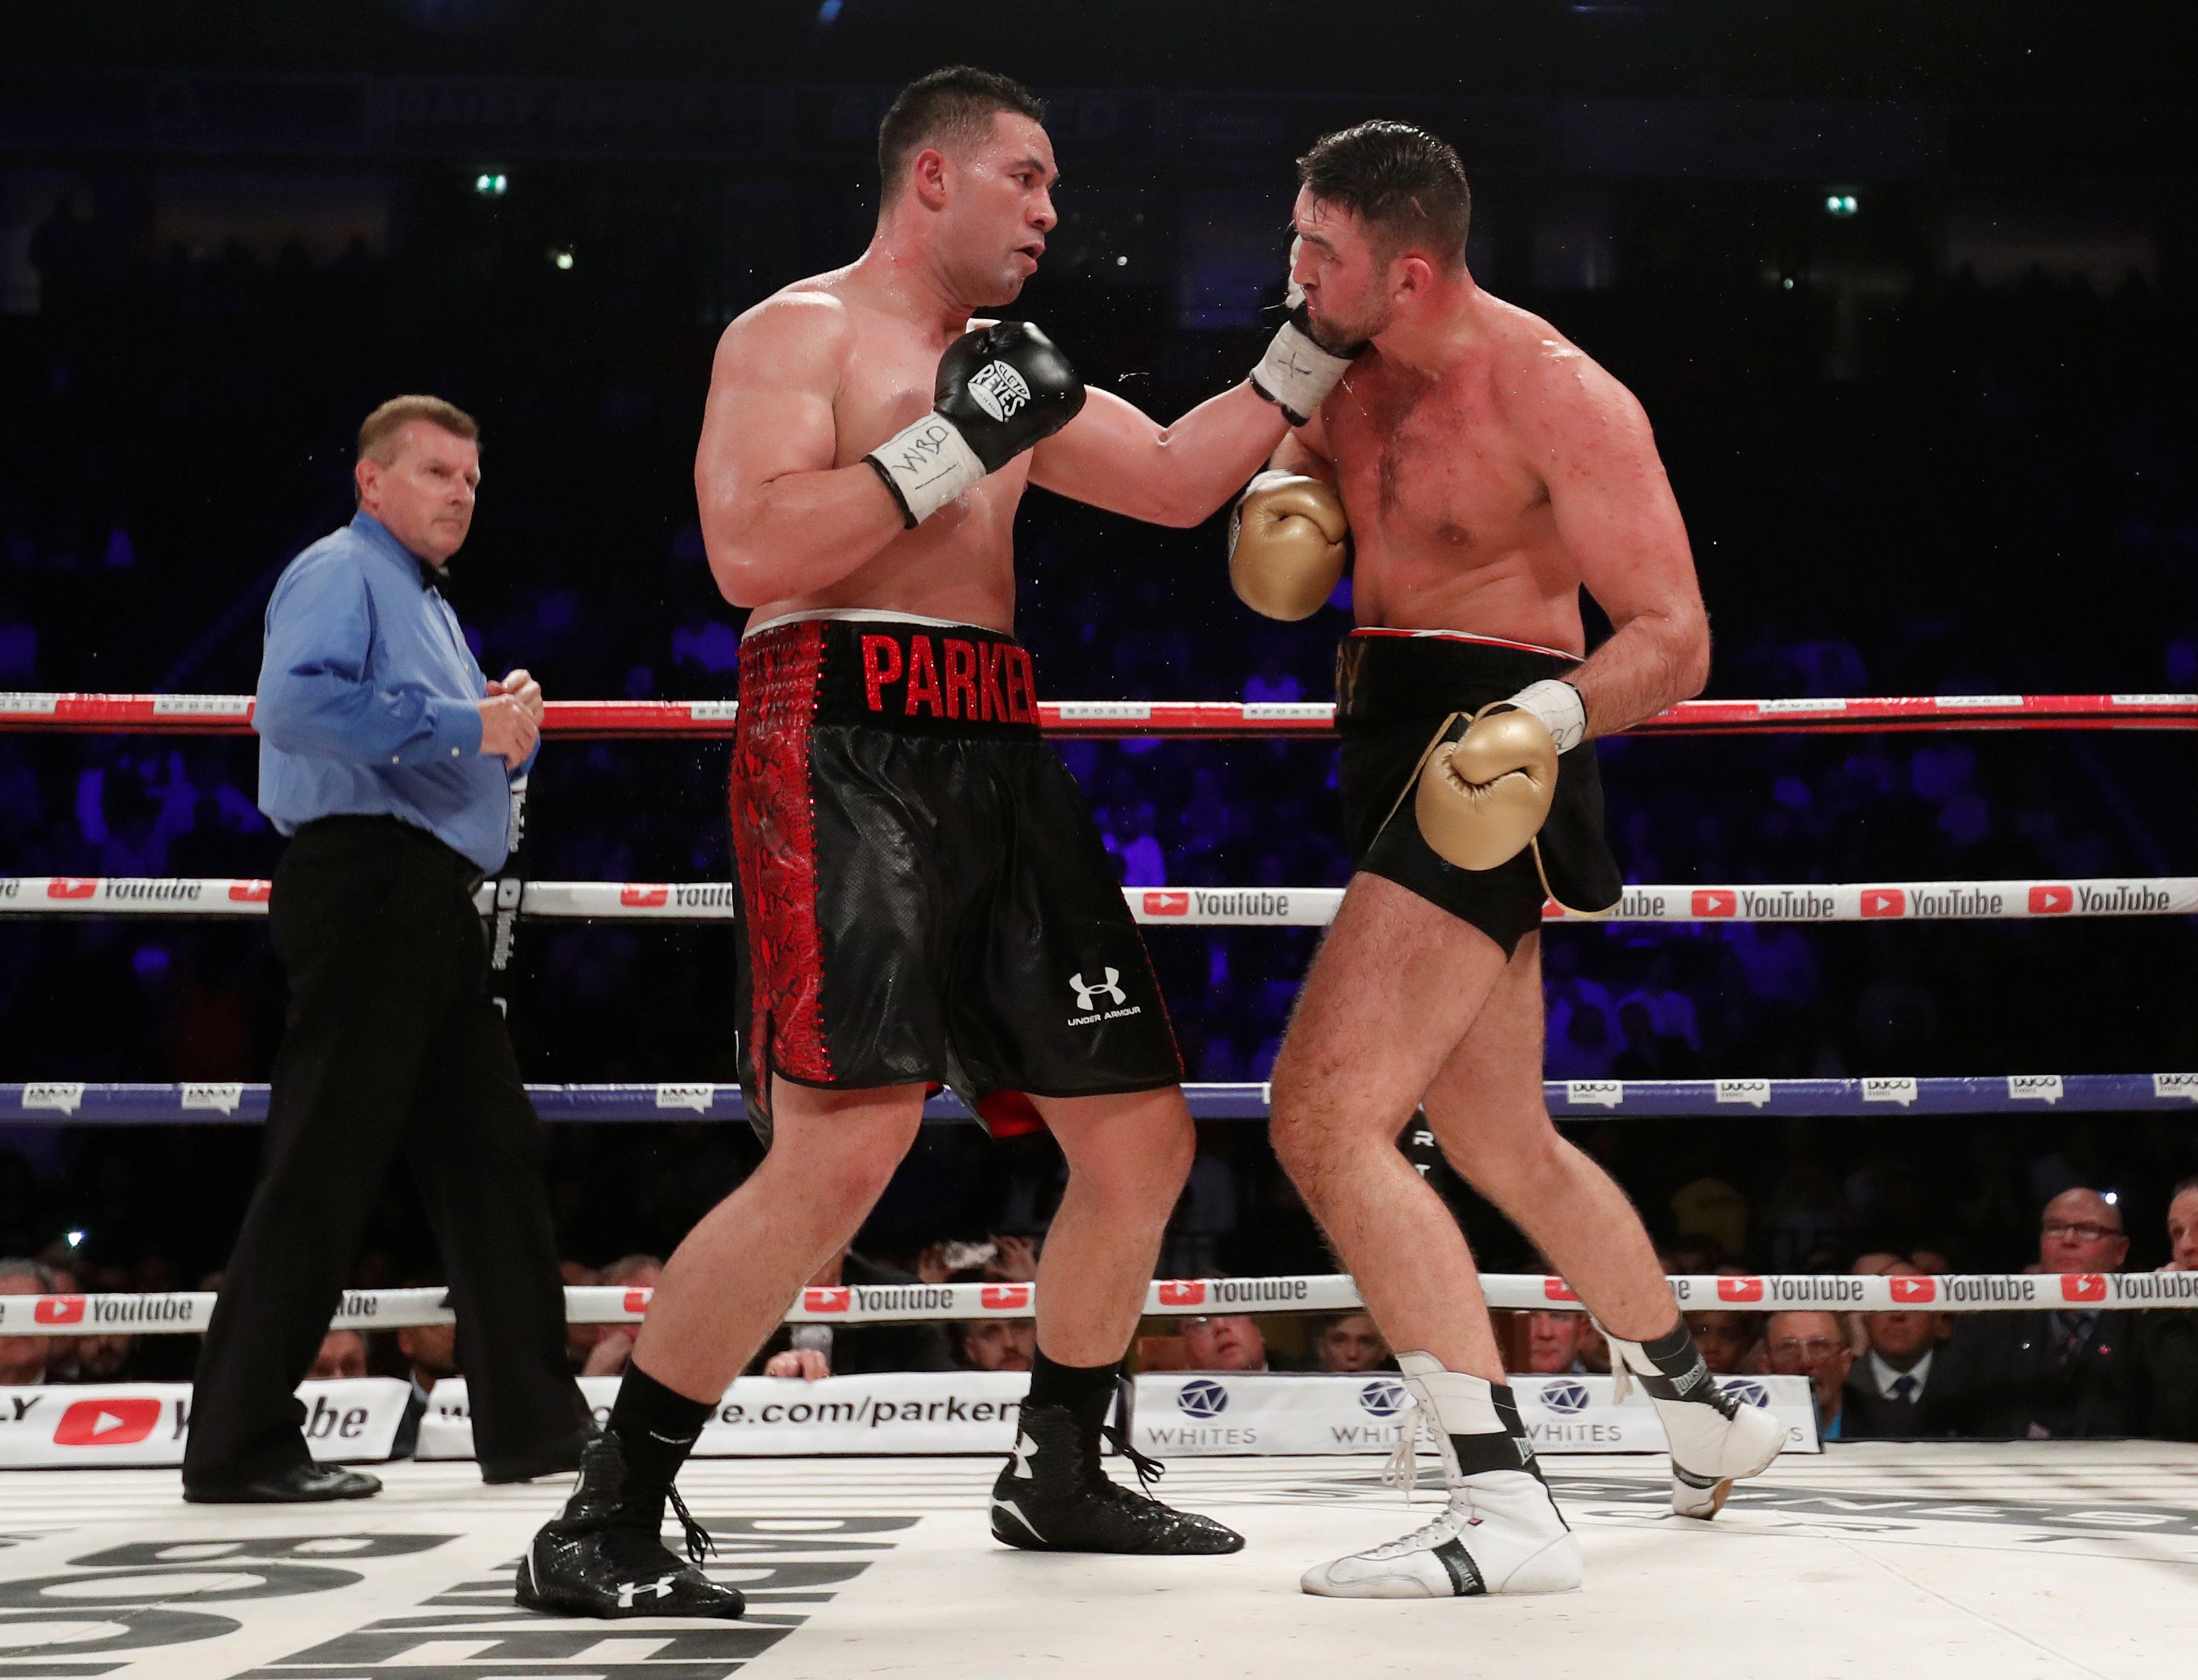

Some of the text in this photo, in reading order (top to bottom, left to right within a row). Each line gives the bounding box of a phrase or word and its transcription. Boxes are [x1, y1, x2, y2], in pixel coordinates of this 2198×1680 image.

[969, 363, 1025, 417] REYES
[892, 425, 949, 474] WBO
[861, 634, 1041, 727] PARKE
[1196, 890, 1289, 916] YouTube
[1741, 890, 1835, 917] YouTube
[1910, 887, 2003, 917] YouTube
[2078, 884, 2170, 913] YouTube
[1067, 1006, 1142, 1027] UNDER ARMOUR
[1721, 1081, 1765, 1091] DUCO
[1868, 1079, 1912, 1090] DUCO
[2014, 1076, 2057, 1087] DUCO
[856, 1287, 954, 1311] YouTube
[1213, 1279, 1308, 1303] YouTube
[1770, 1275, 1864, 1300] YouTube
[1941, 1275, 2035, 1302] YouTube
[94, 1294, 193, 1322] YouTube
[1147, 1426, 1257, 1445] WHITES
[1525, 1423, 1622, 1442] WHITES
